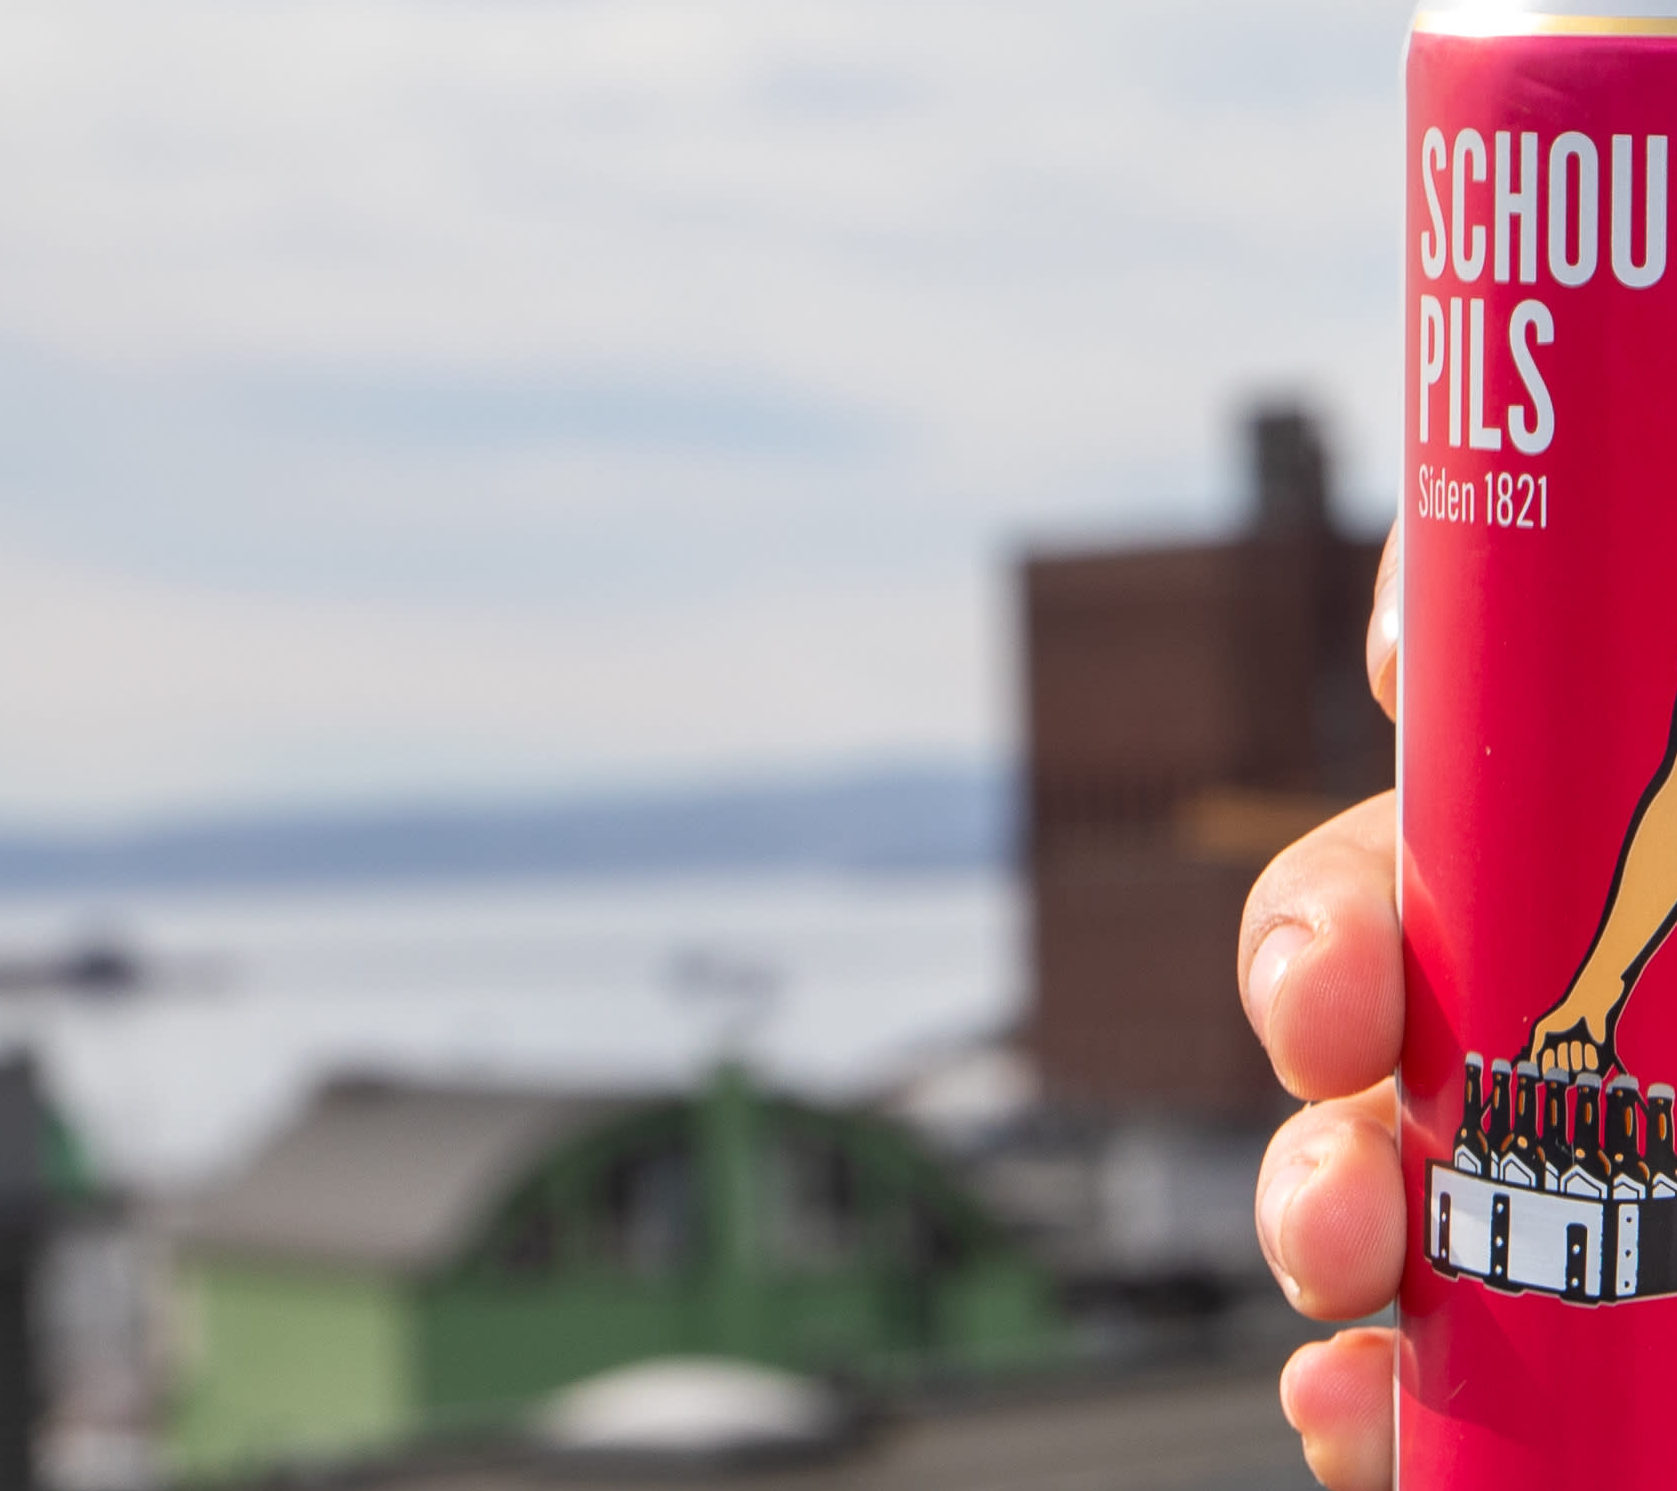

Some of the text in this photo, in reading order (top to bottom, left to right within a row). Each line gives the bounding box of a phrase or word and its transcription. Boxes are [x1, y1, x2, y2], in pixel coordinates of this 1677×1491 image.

[1418, 293, 1556, 456] PILS
[1418, 463, 1548, 530] Siden 1821
